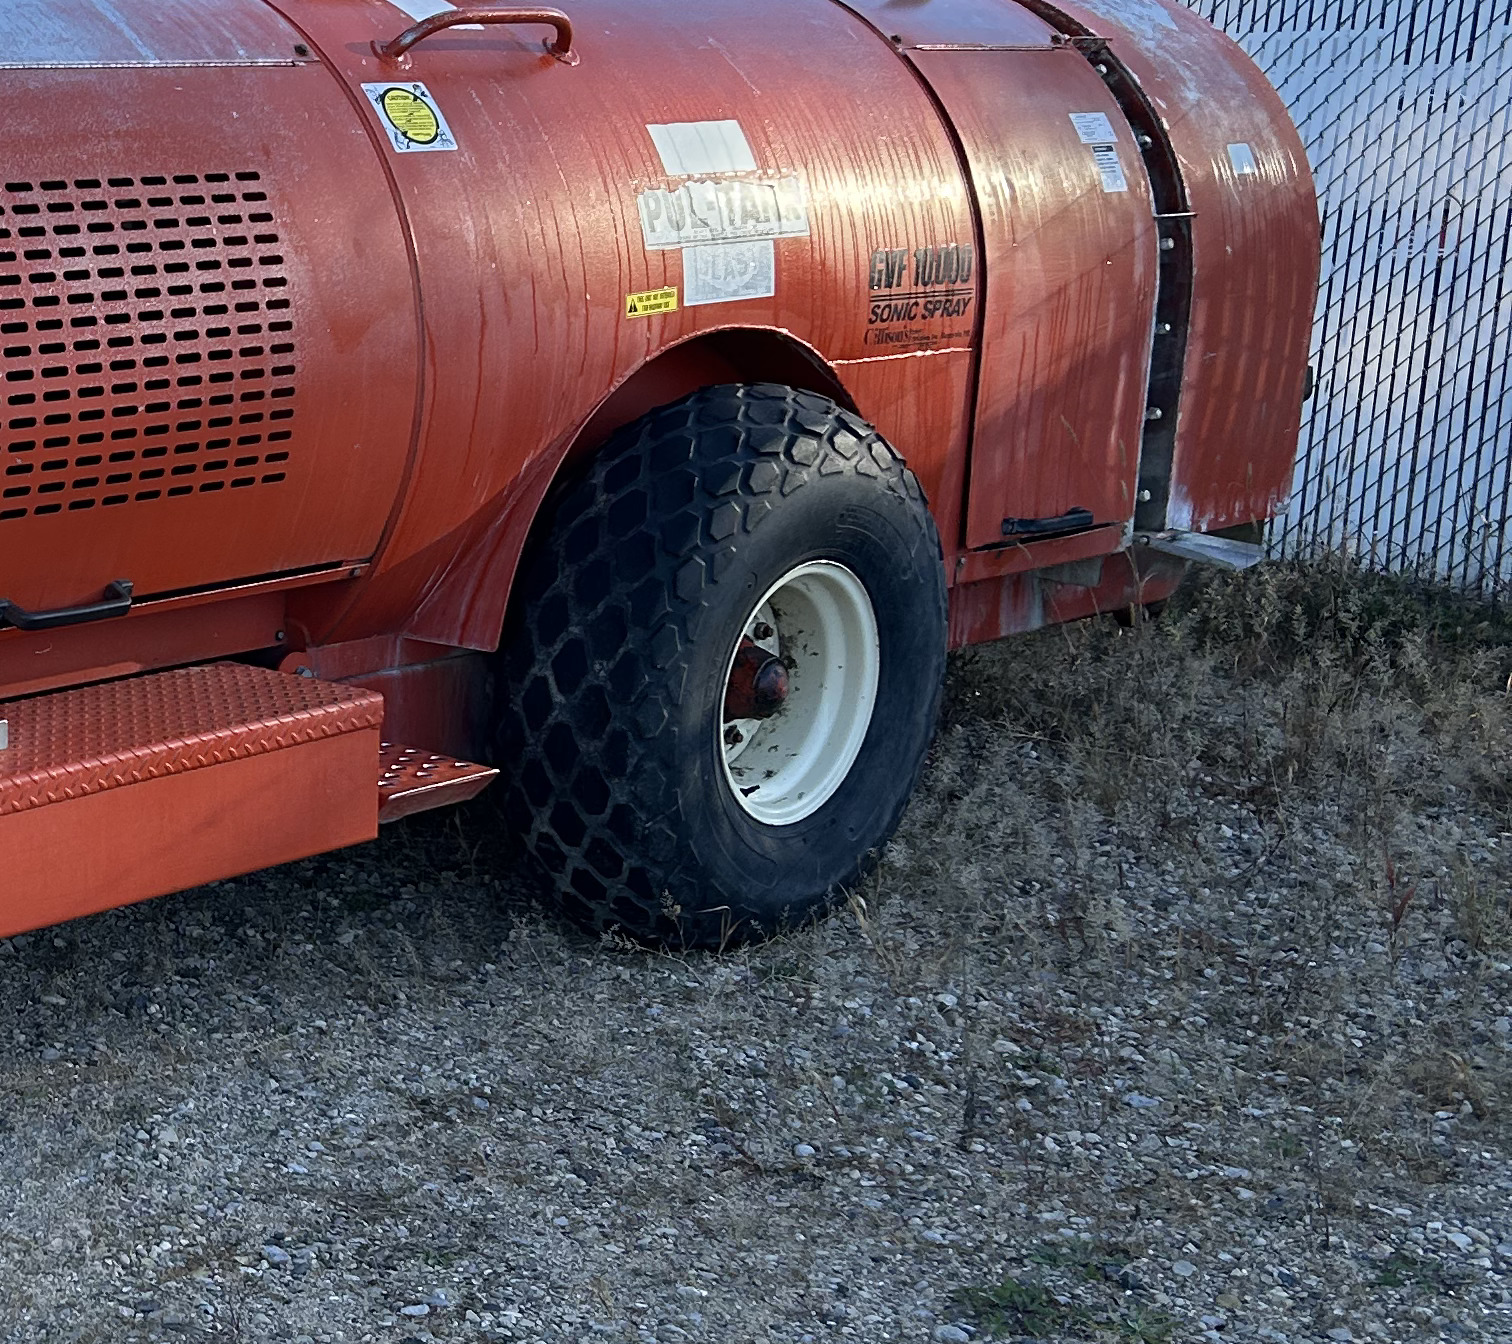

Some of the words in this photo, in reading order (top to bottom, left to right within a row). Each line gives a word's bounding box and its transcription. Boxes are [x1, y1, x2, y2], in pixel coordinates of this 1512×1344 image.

[869, 248, 908, 290] GVF
[868, 300, 919, 325] SONIC
[921, 296, 972, 320] SPRAY
